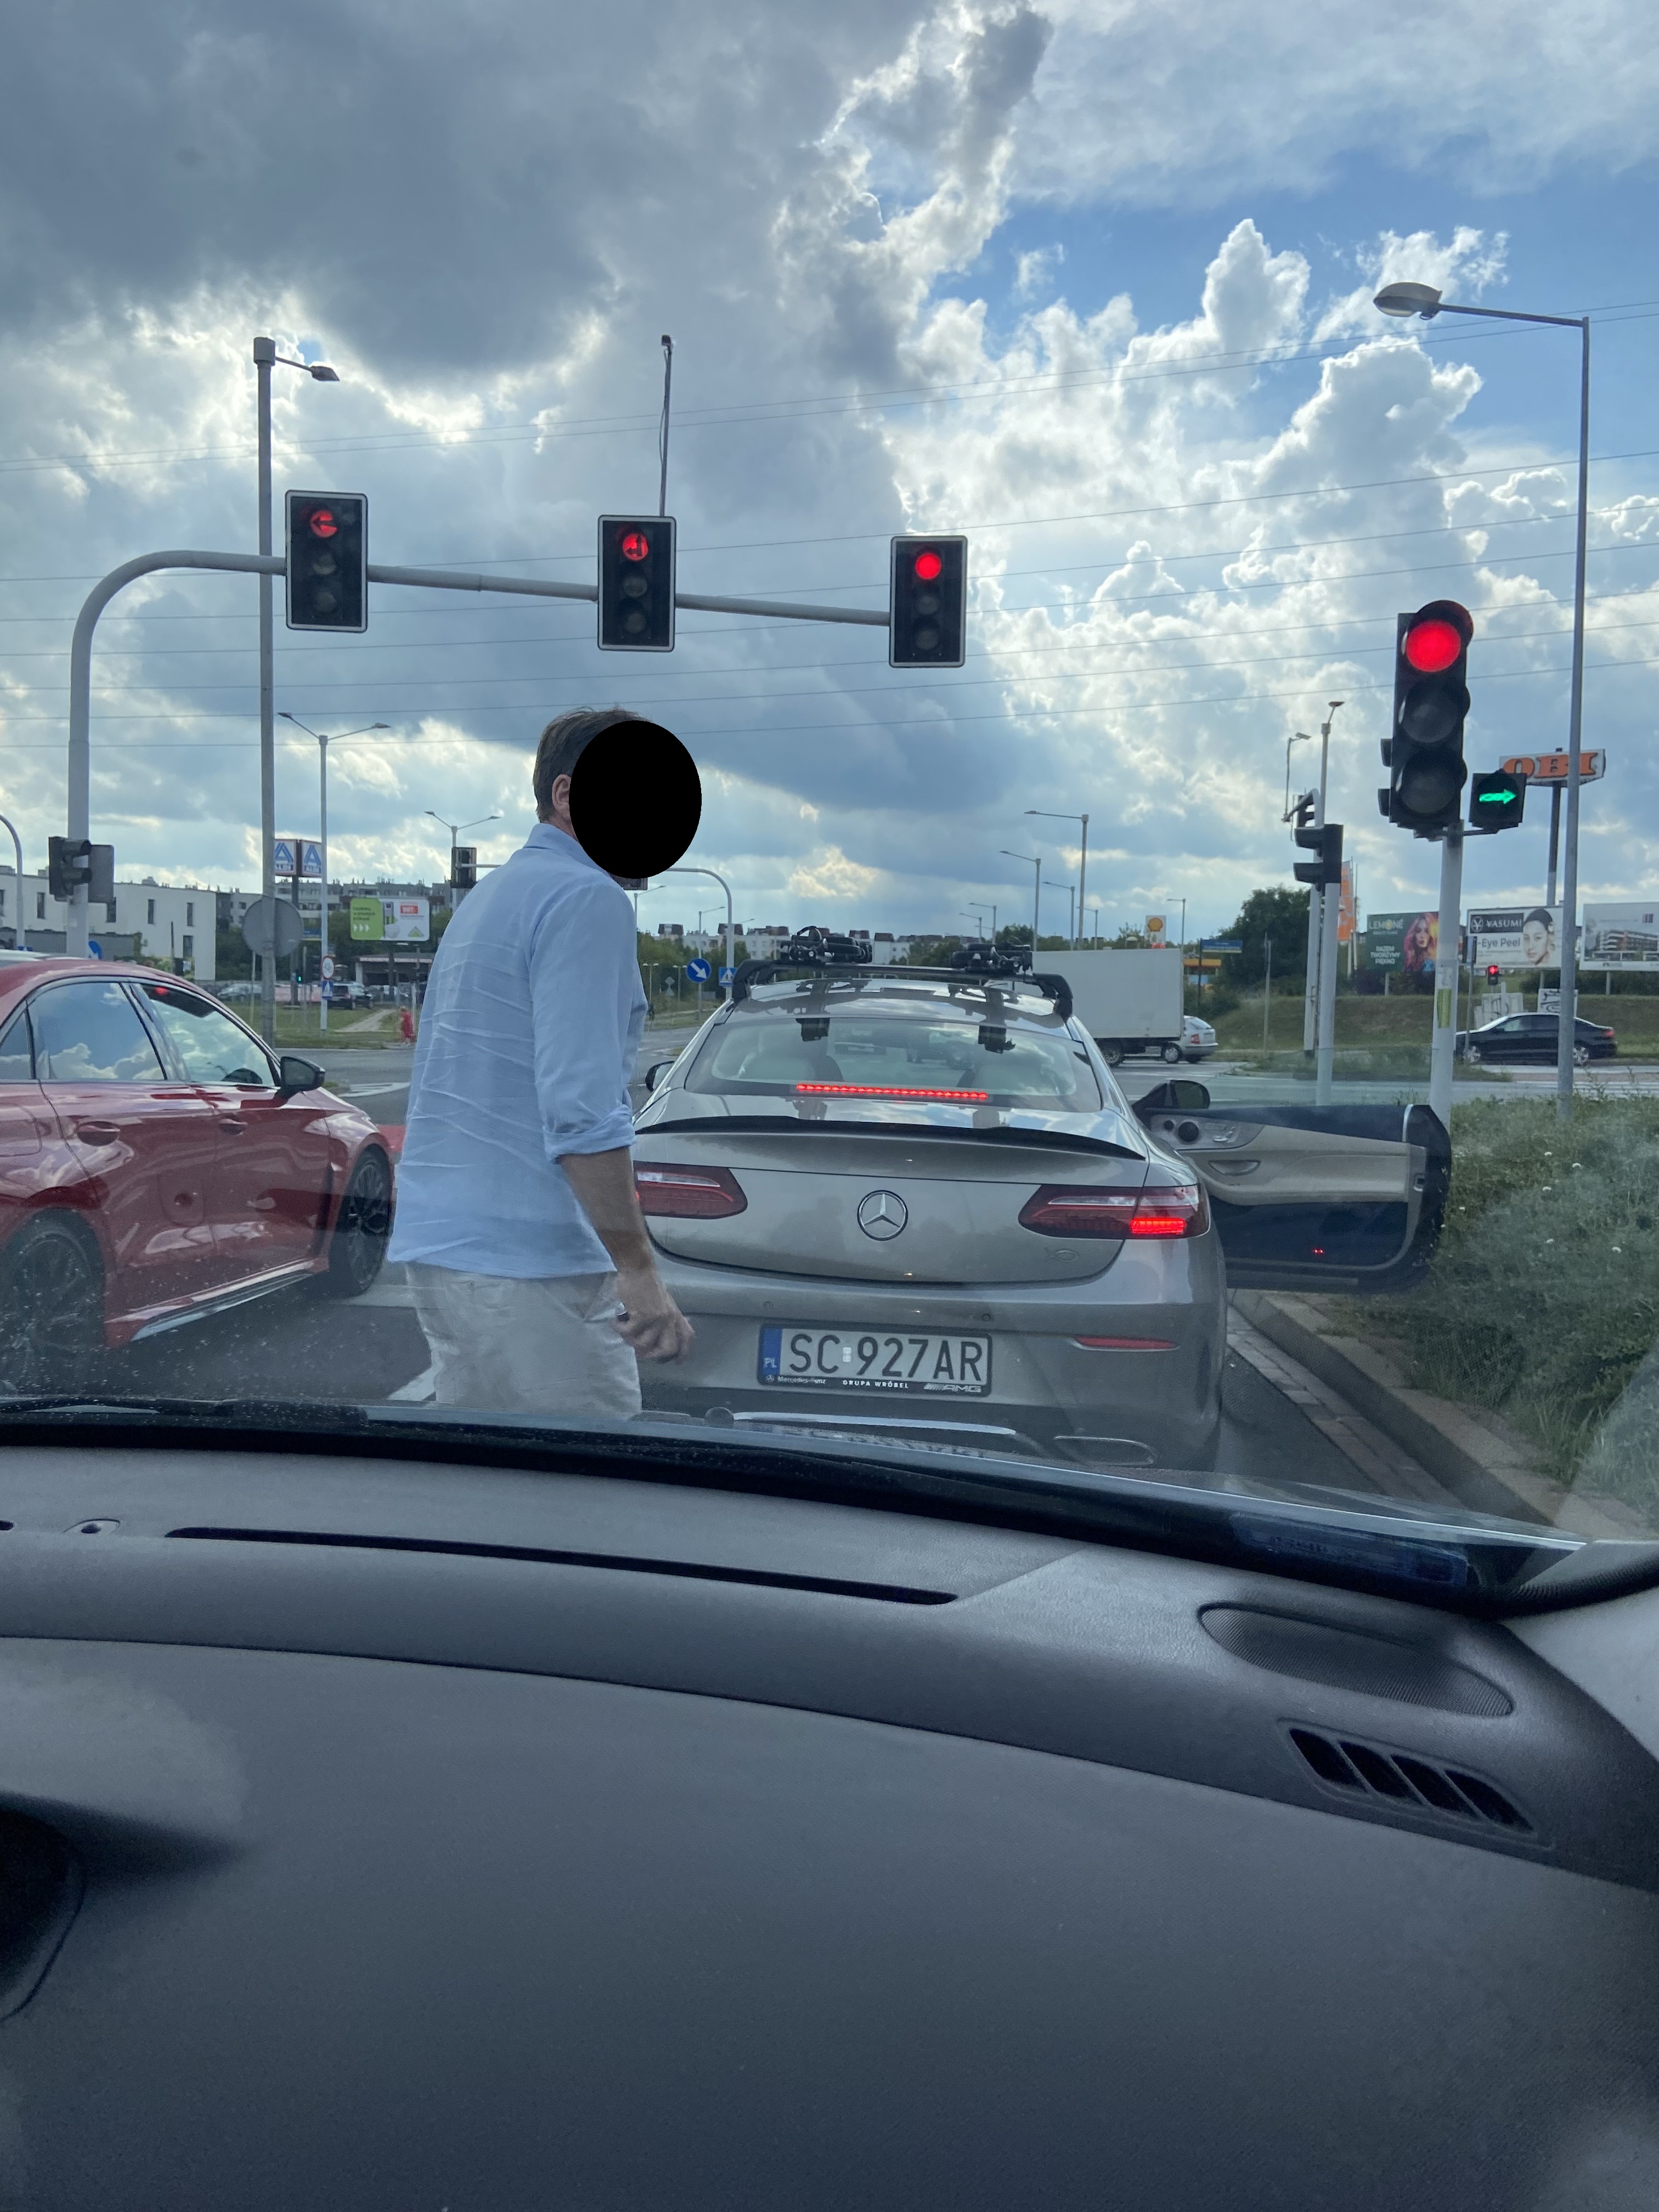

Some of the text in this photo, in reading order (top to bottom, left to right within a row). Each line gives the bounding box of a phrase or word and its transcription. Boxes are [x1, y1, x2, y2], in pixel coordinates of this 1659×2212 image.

[1503, 752, 1598, 778] OBI
[1500, 937, 1521, 947] Peel
[763, 1357, 777, 1369] PL
[789, 1334, 983, 1381] SC 927AR
[874, 1380, 909, 1389] WRÓBEL
[942, 1384, 981, 1393] AMG
